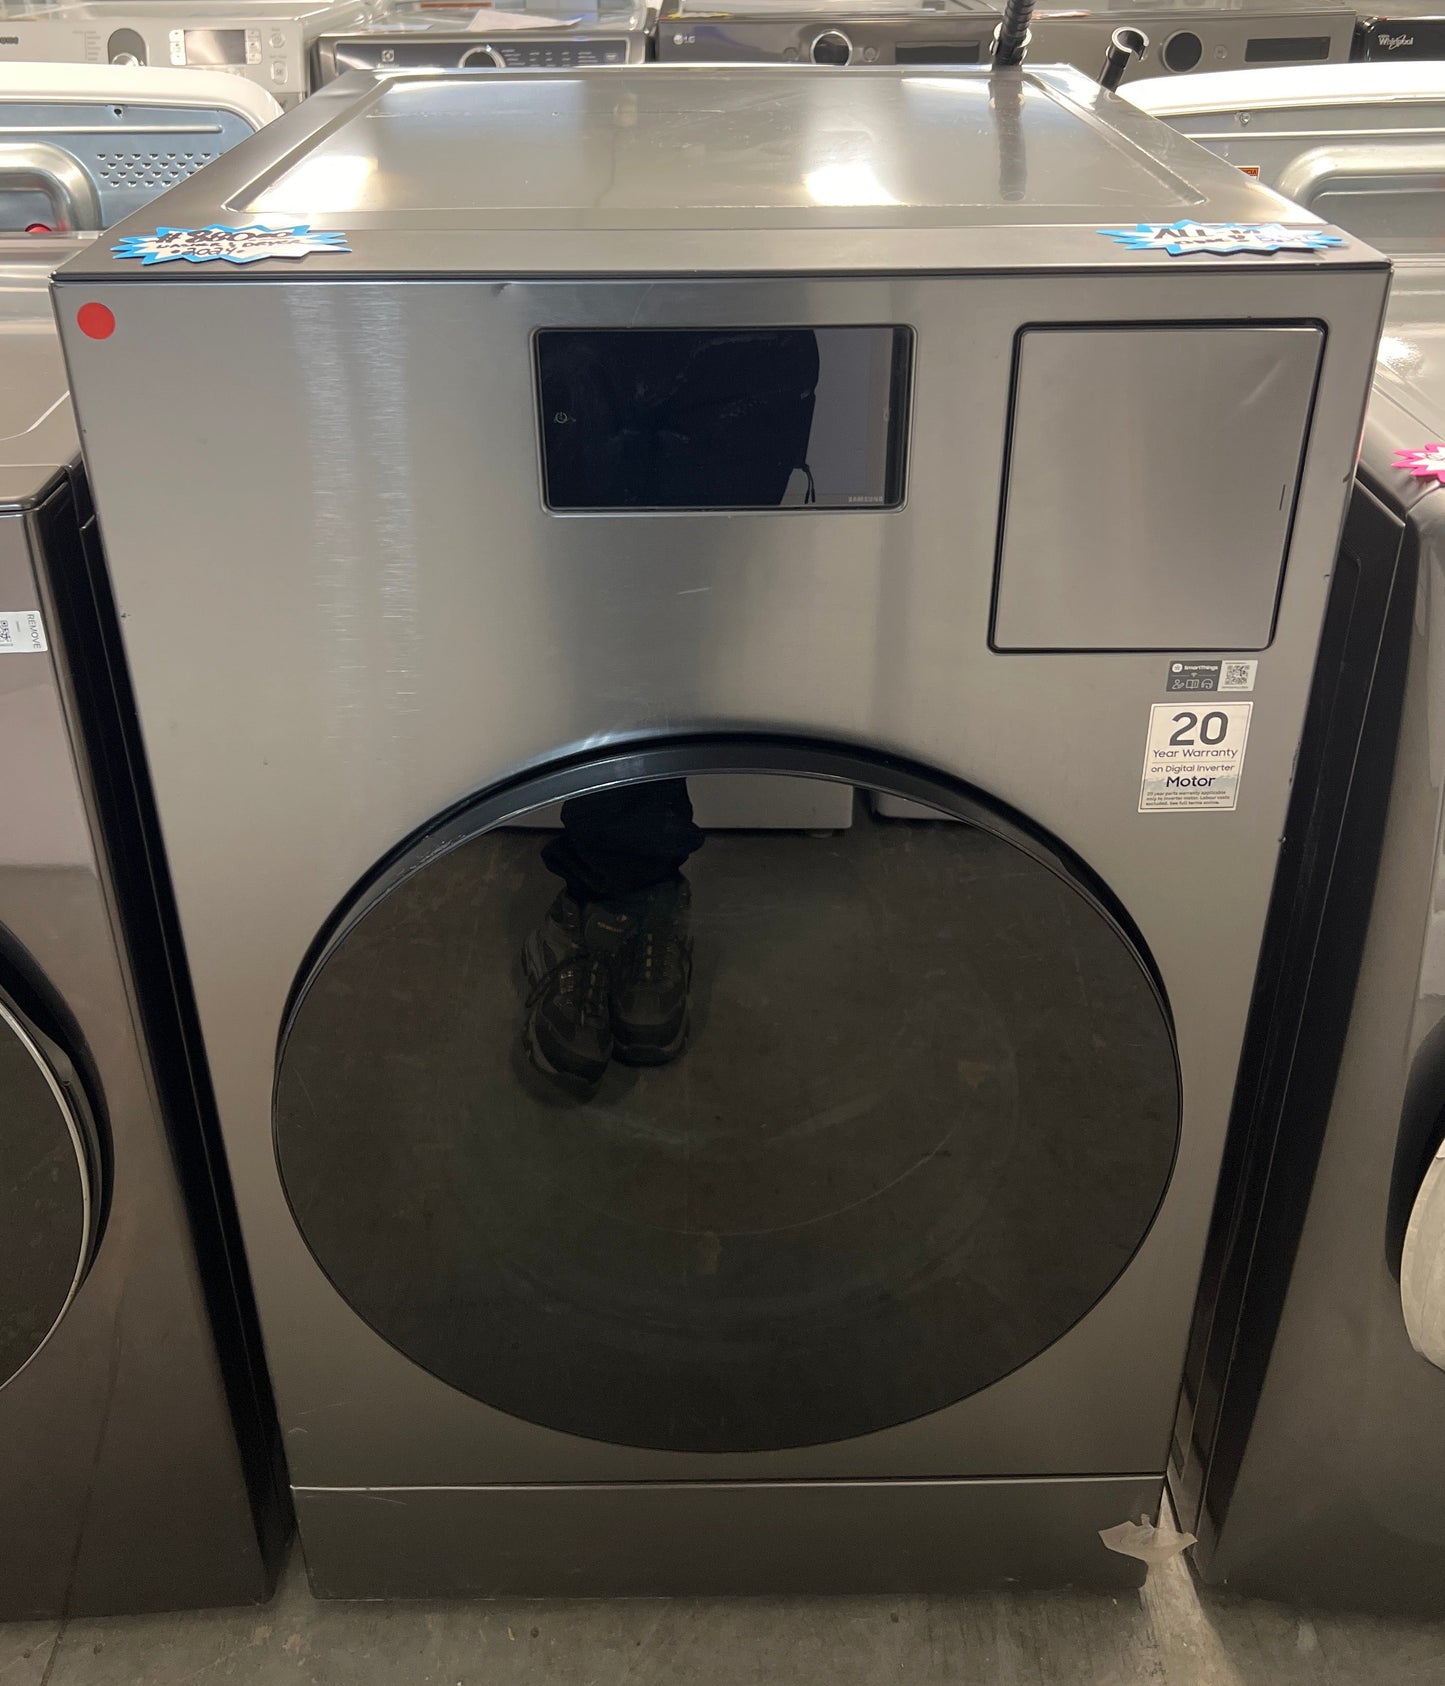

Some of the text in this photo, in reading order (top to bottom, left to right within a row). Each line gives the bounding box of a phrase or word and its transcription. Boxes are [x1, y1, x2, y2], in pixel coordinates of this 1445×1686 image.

[1378, 34, 1414, 50] Whirlpool
[27, 614, 41, 649] REMOVE
[1184, 664, 1219, 672] SmartThings
[1169, 711, 1228, 746] 20
[1153, 748, 1239, 759] Year Warranty
[1165, 765, 1195, 774] Digital
[1196, 764, 1236, 772] Inverter
[1166, 776, 1216, 787] Motor
